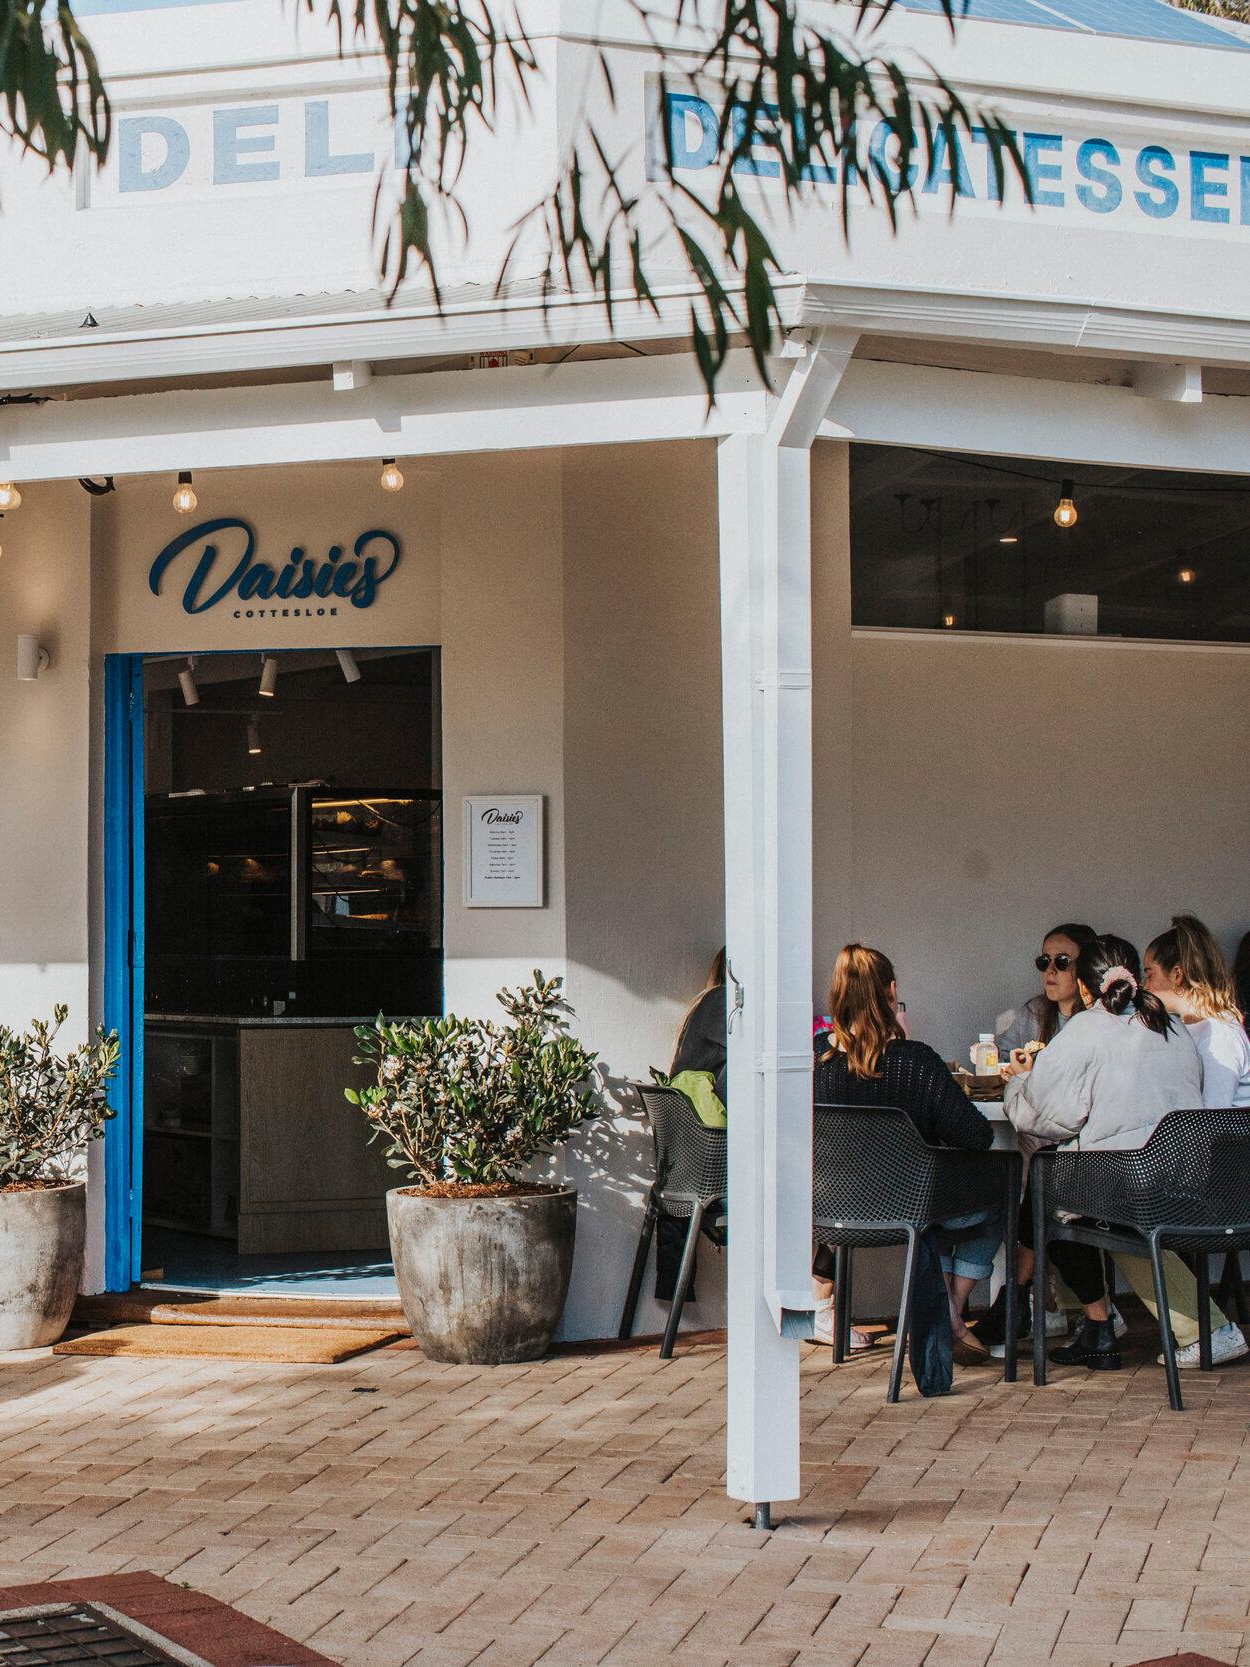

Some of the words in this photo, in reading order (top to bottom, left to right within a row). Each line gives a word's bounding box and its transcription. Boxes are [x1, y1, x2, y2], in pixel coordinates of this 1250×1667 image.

[119, 93, 421, 192] DELI
[149, 517, 402, 615] Daisies
[233, 607, 338, 619] COTTESLOE
[481, 808, 524, 824] Daisies
